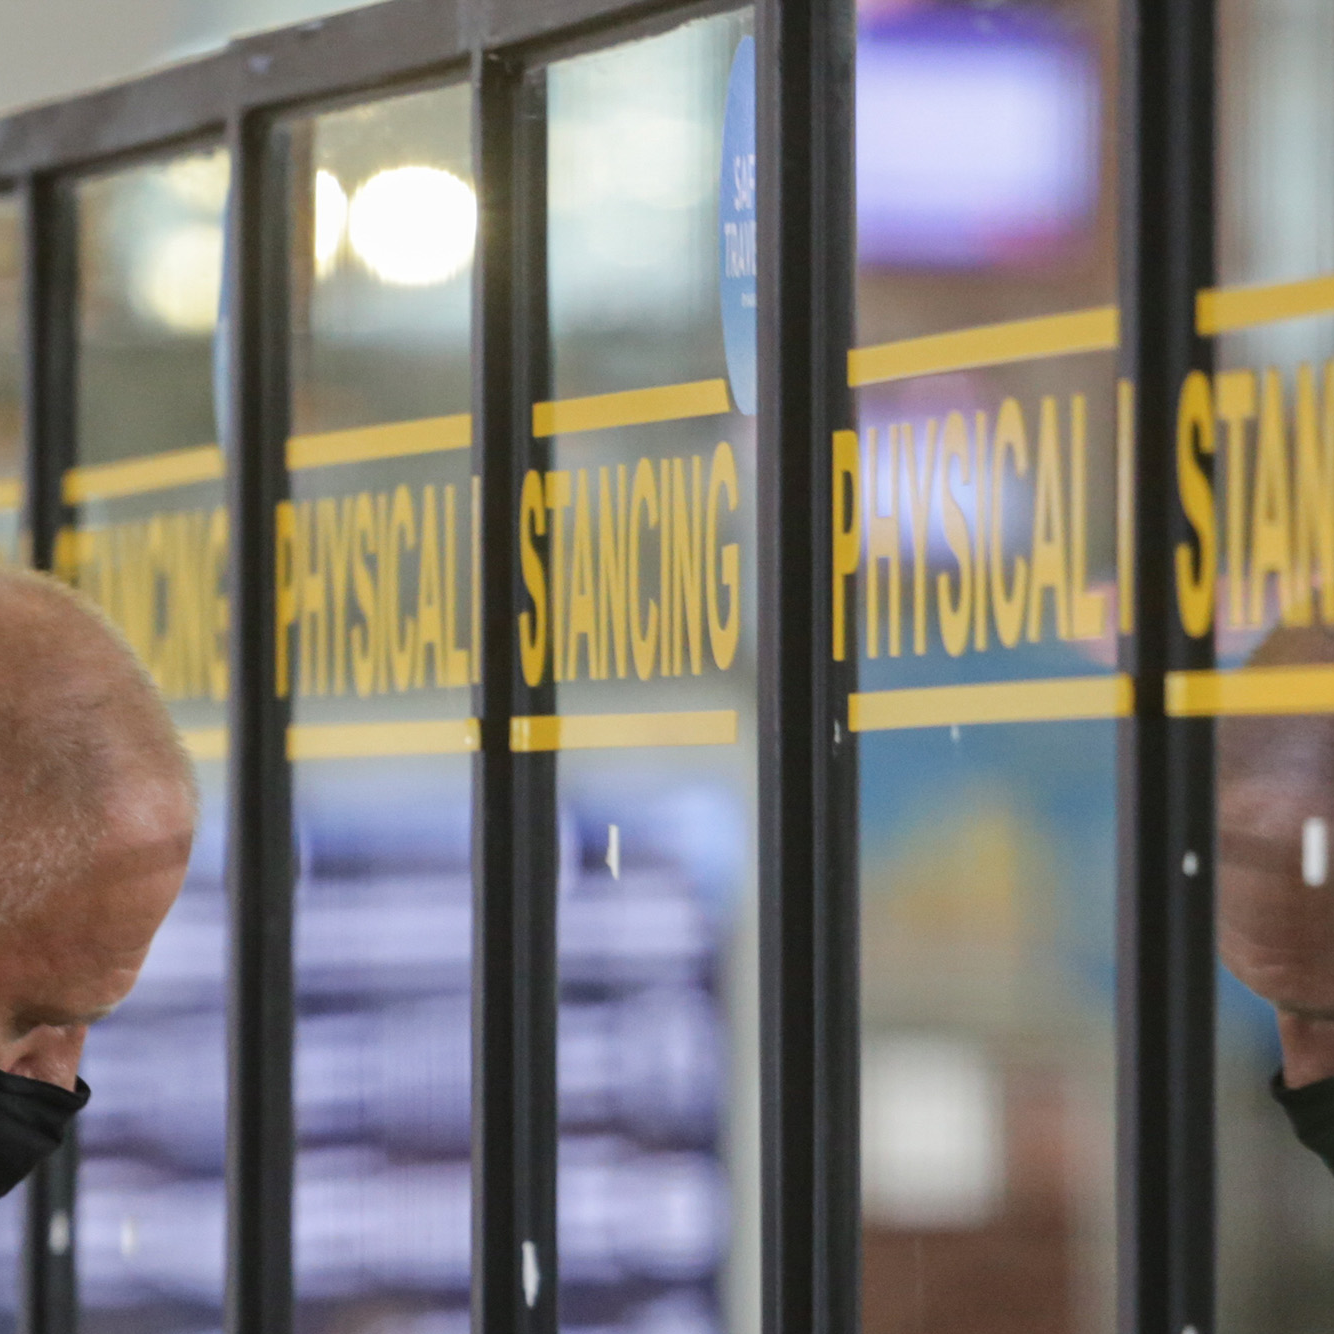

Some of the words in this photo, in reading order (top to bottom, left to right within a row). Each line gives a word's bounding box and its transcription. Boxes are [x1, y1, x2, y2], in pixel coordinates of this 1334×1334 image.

[275, 483, 469, 698] PHYSICAL
[472, 441, 739, 687] STANCING
[832, 394, 1111, 662] PHYSICAL
